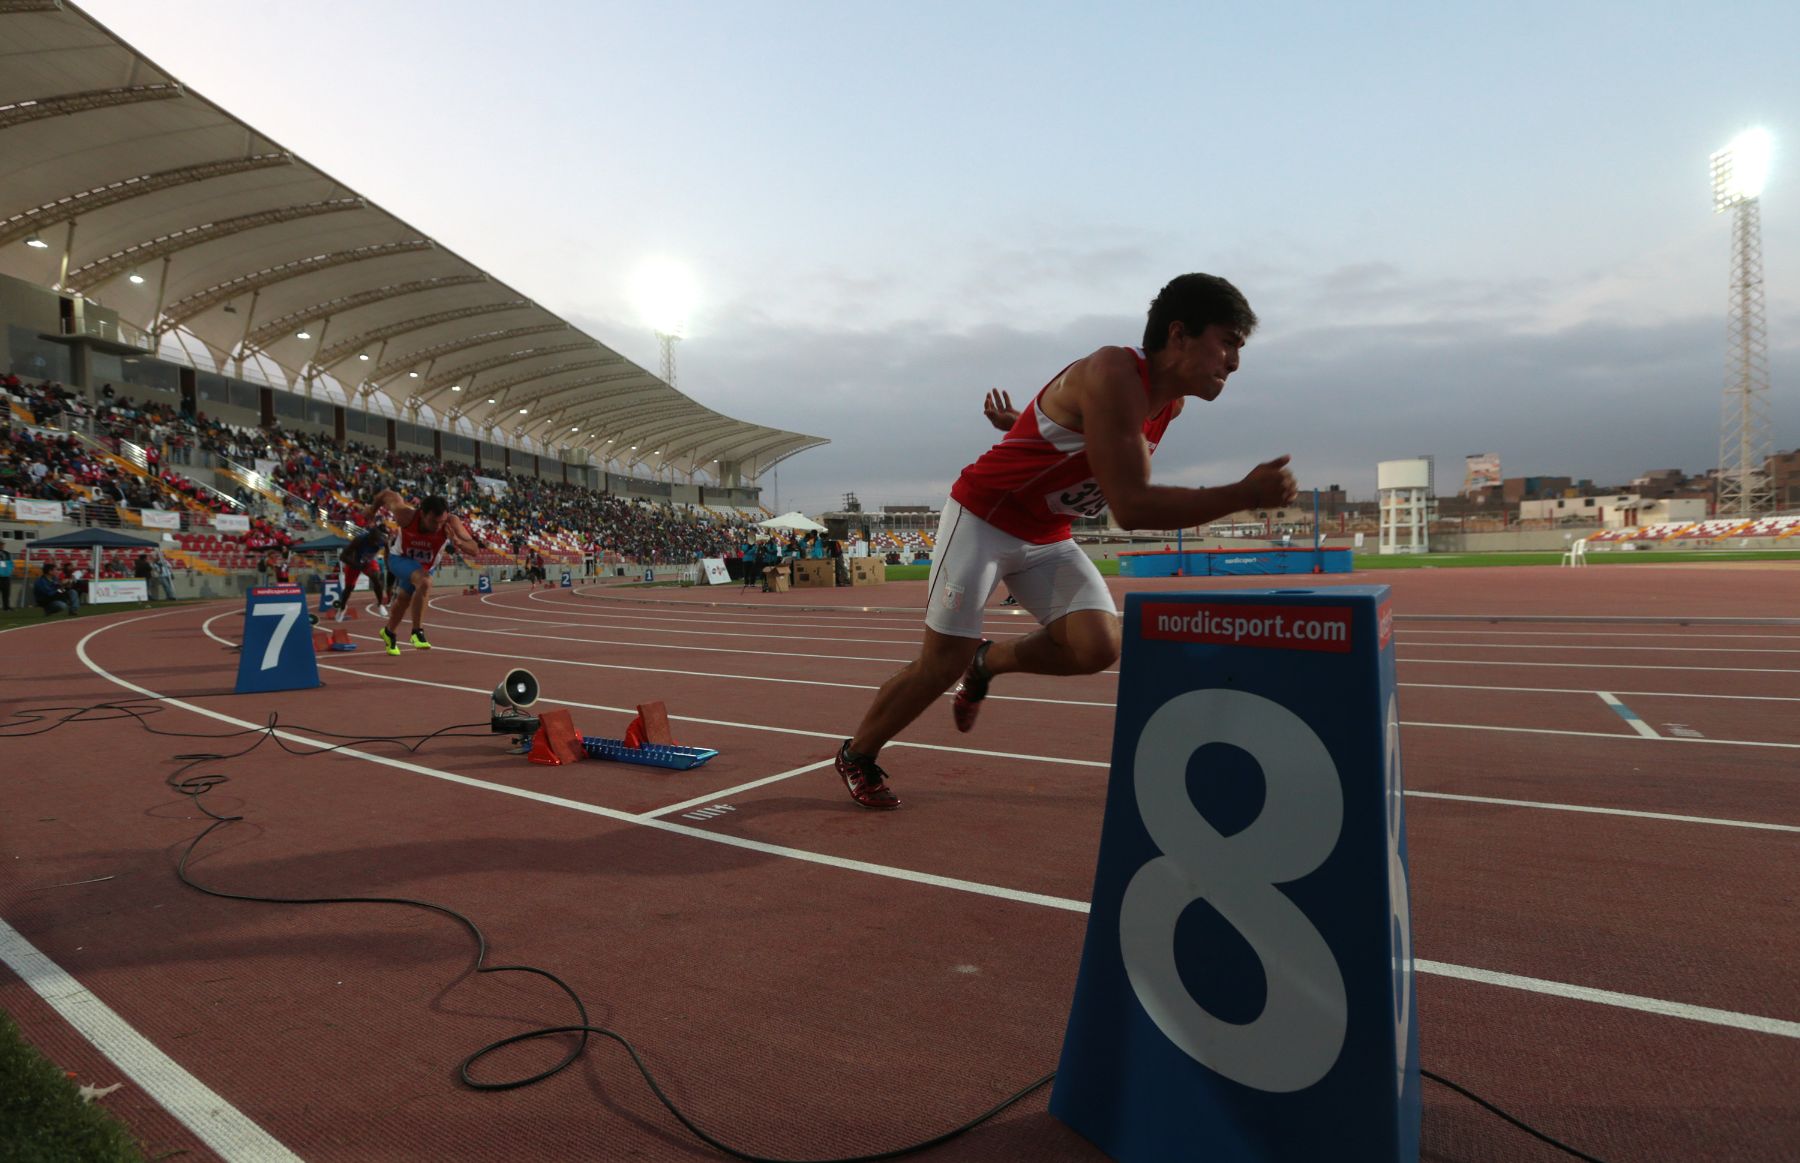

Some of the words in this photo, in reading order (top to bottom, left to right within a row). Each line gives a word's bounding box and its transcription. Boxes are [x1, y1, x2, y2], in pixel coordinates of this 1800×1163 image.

[480, 577, 489, 590] 3
[562, 574, 570, 585] 2
[325, 583, 339, 606] 5
[252, 602, 302, 671] 7
[1158, 610, 1346, 642] nordicsport.com
[1119, 688, 1348, 1093] 8
